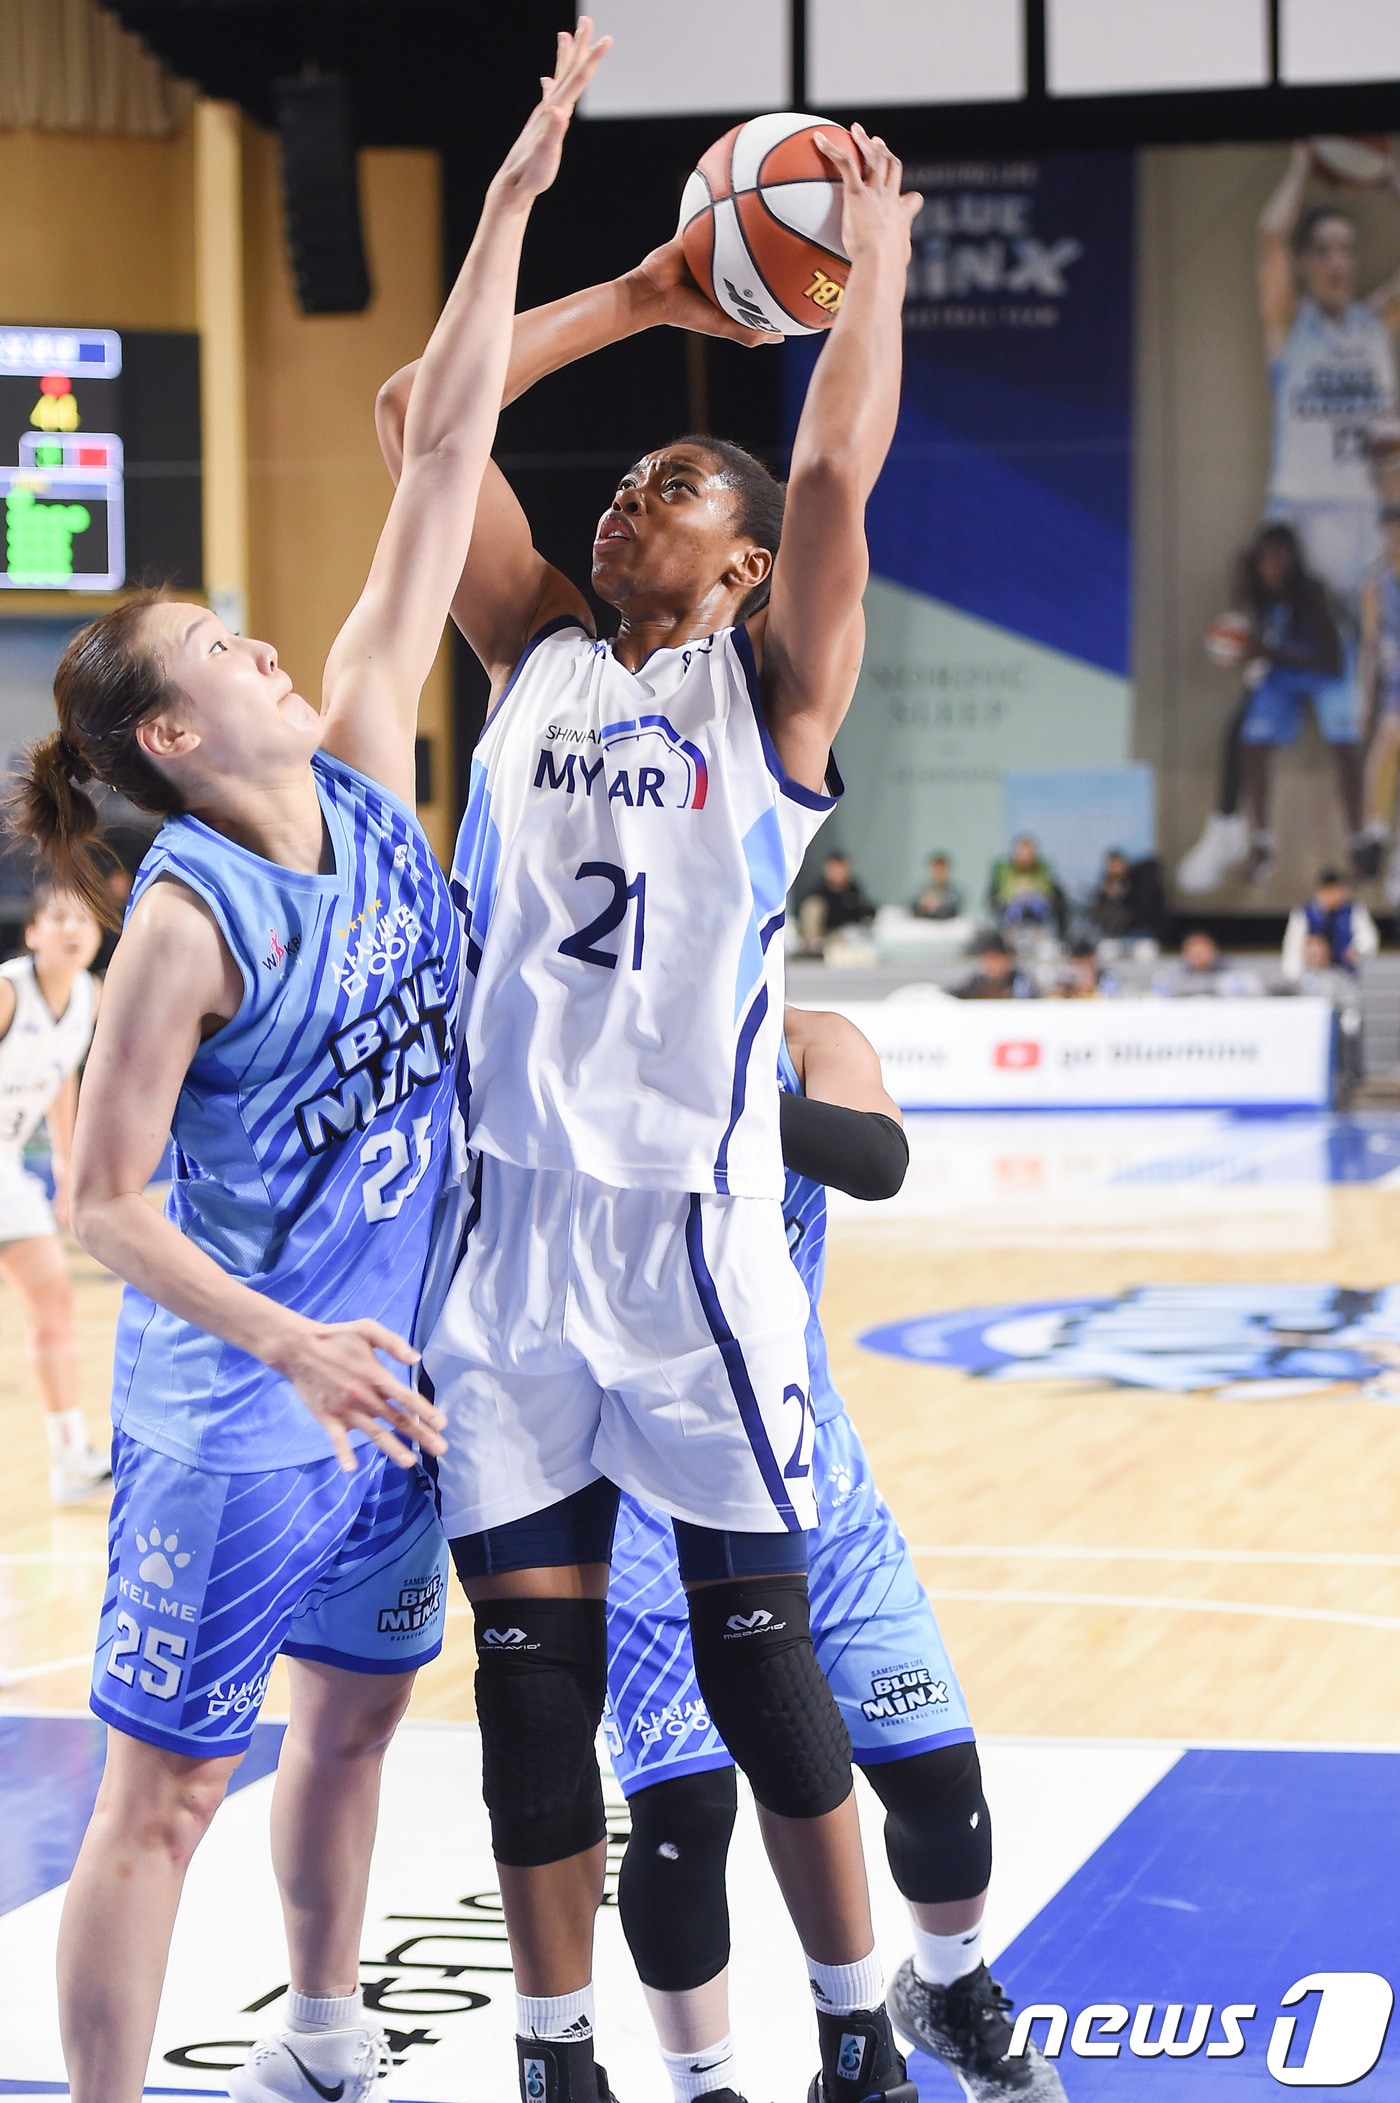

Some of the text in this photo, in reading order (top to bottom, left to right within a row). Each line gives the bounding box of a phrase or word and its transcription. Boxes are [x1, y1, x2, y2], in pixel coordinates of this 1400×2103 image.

[557, 861, 647, 971] 21
[331, 903, 422, 999] 삼성생명
[119, 1576, 198, 1622] KELME
[400, 1574, 441, 1608] BLUE
[107, 1611, 188, 1701] 25
[871, 1662, 909, 1677] SAMSUNG
[872, 1668, 931, 1697] BLUE
